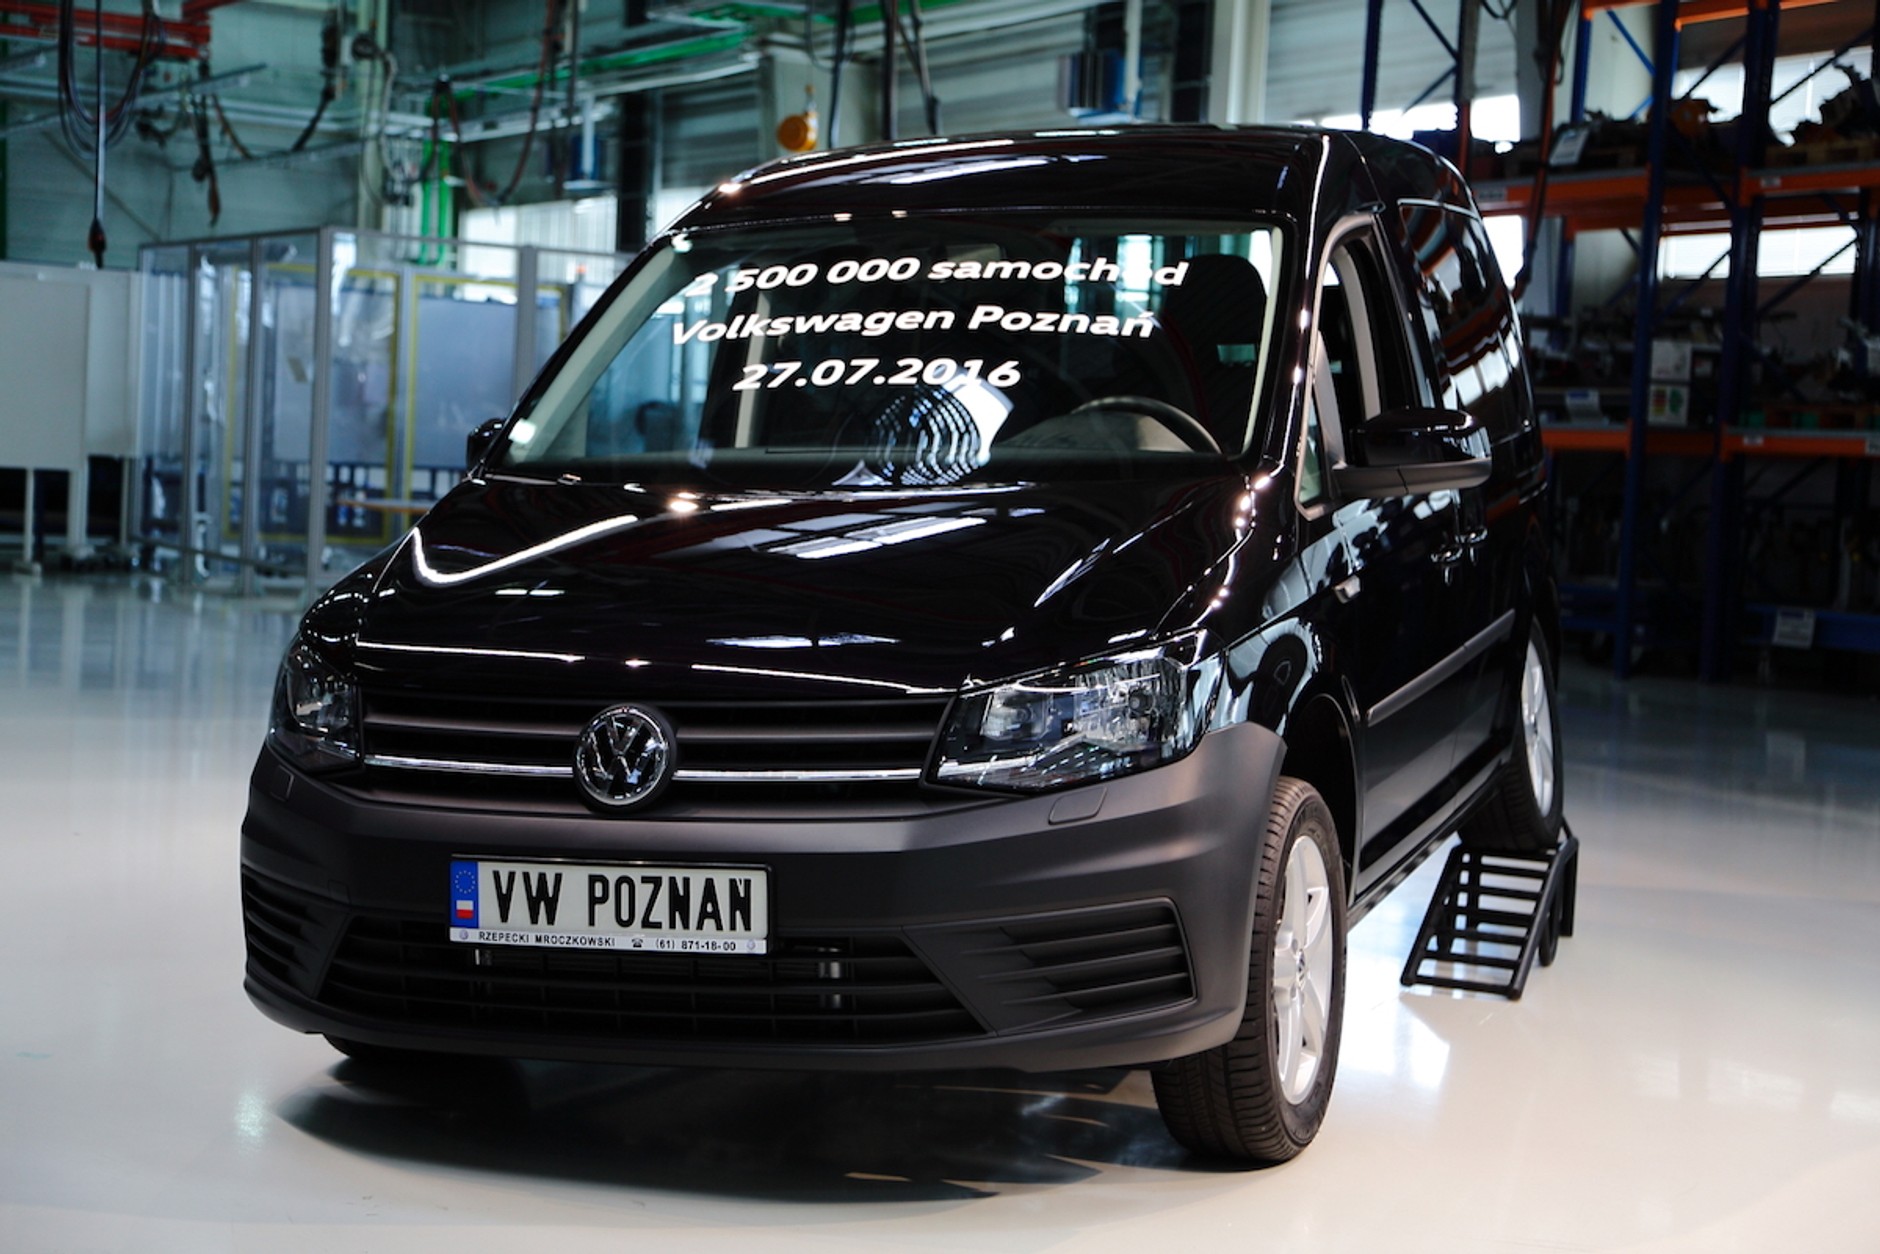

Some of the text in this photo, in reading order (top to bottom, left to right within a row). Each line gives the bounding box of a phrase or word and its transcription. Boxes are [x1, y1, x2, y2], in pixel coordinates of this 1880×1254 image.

[685, 257, 1190, 297] 2 500 000 samochd
[673, 304, 1155, 345] Volkswagen Poznań
[732, 357, 1021, 391] 27.07.2016
[493, 870, 563, 926] VW
[479, 931, 530, 943] RZEPECKI
[534, 935, 616, 947] MROCZKOWSKI
[655, 938, 675, 950] (61)
